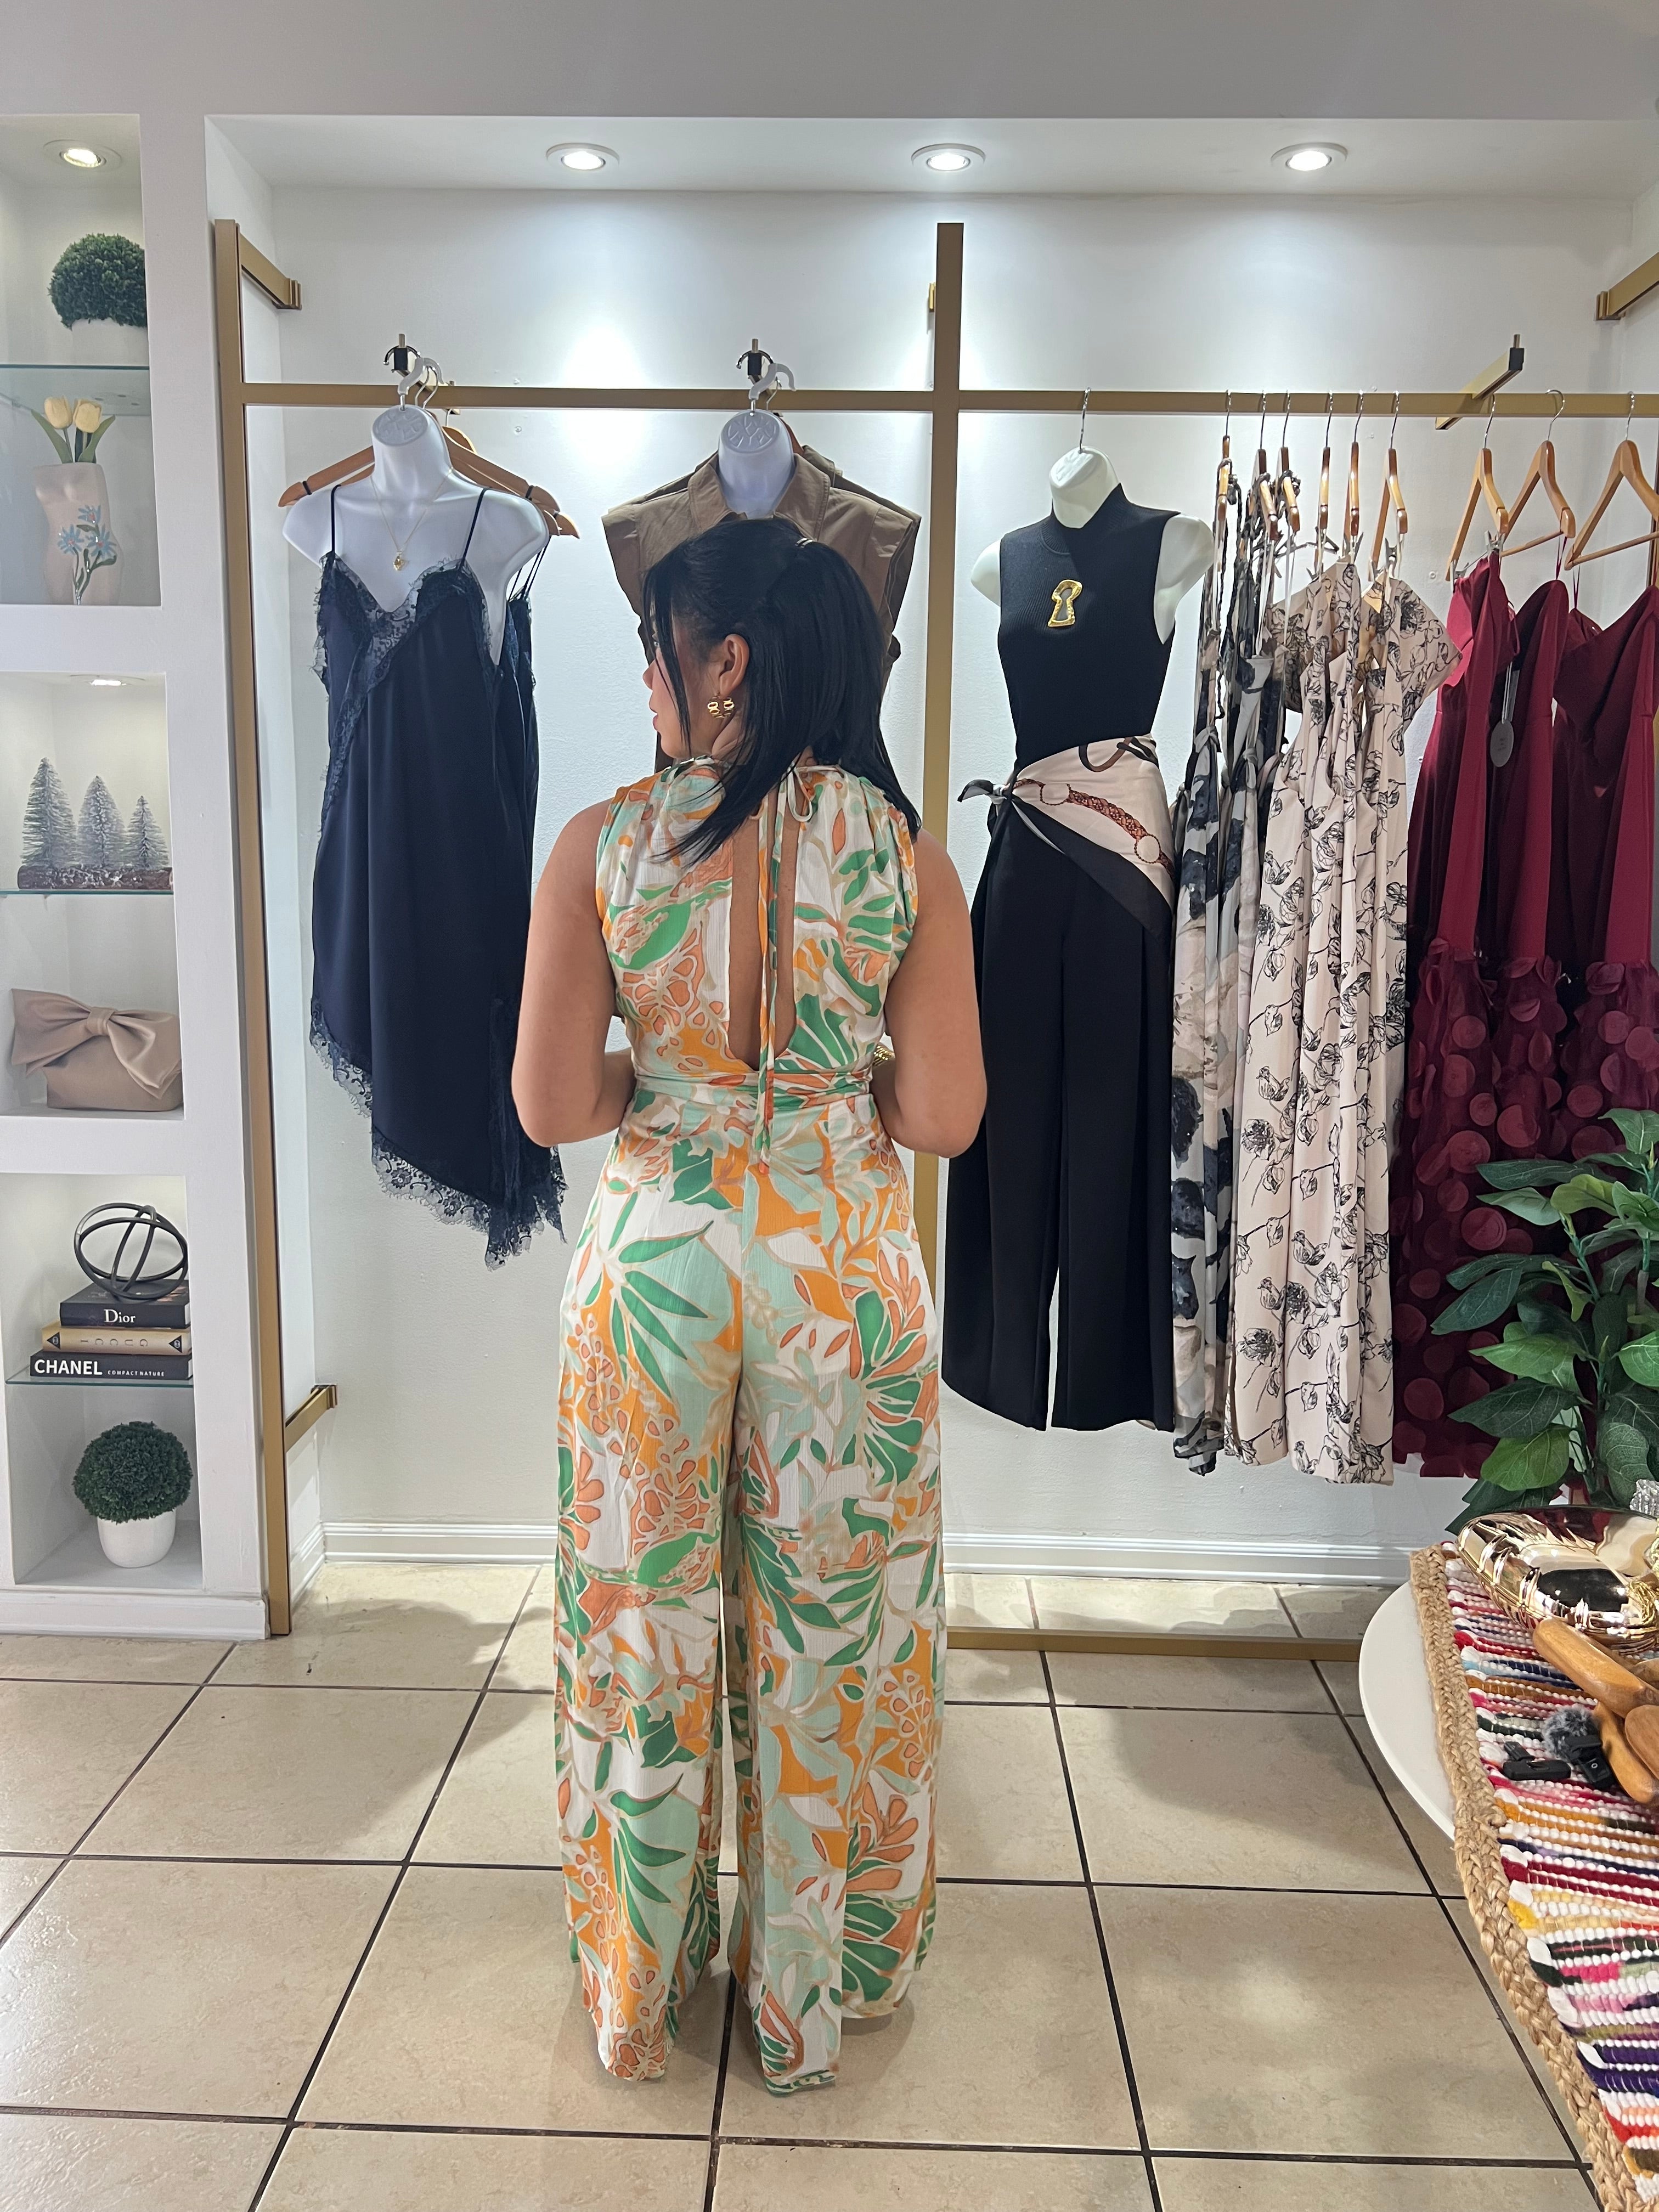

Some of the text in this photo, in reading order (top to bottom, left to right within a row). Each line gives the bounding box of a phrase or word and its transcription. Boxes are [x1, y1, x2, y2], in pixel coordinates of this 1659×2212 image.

[104, 1309, 136, 1323] Dior
[80, 1338, 148, 1347] GUCCI
[34, 1359, 103, 1375] CHANEL
